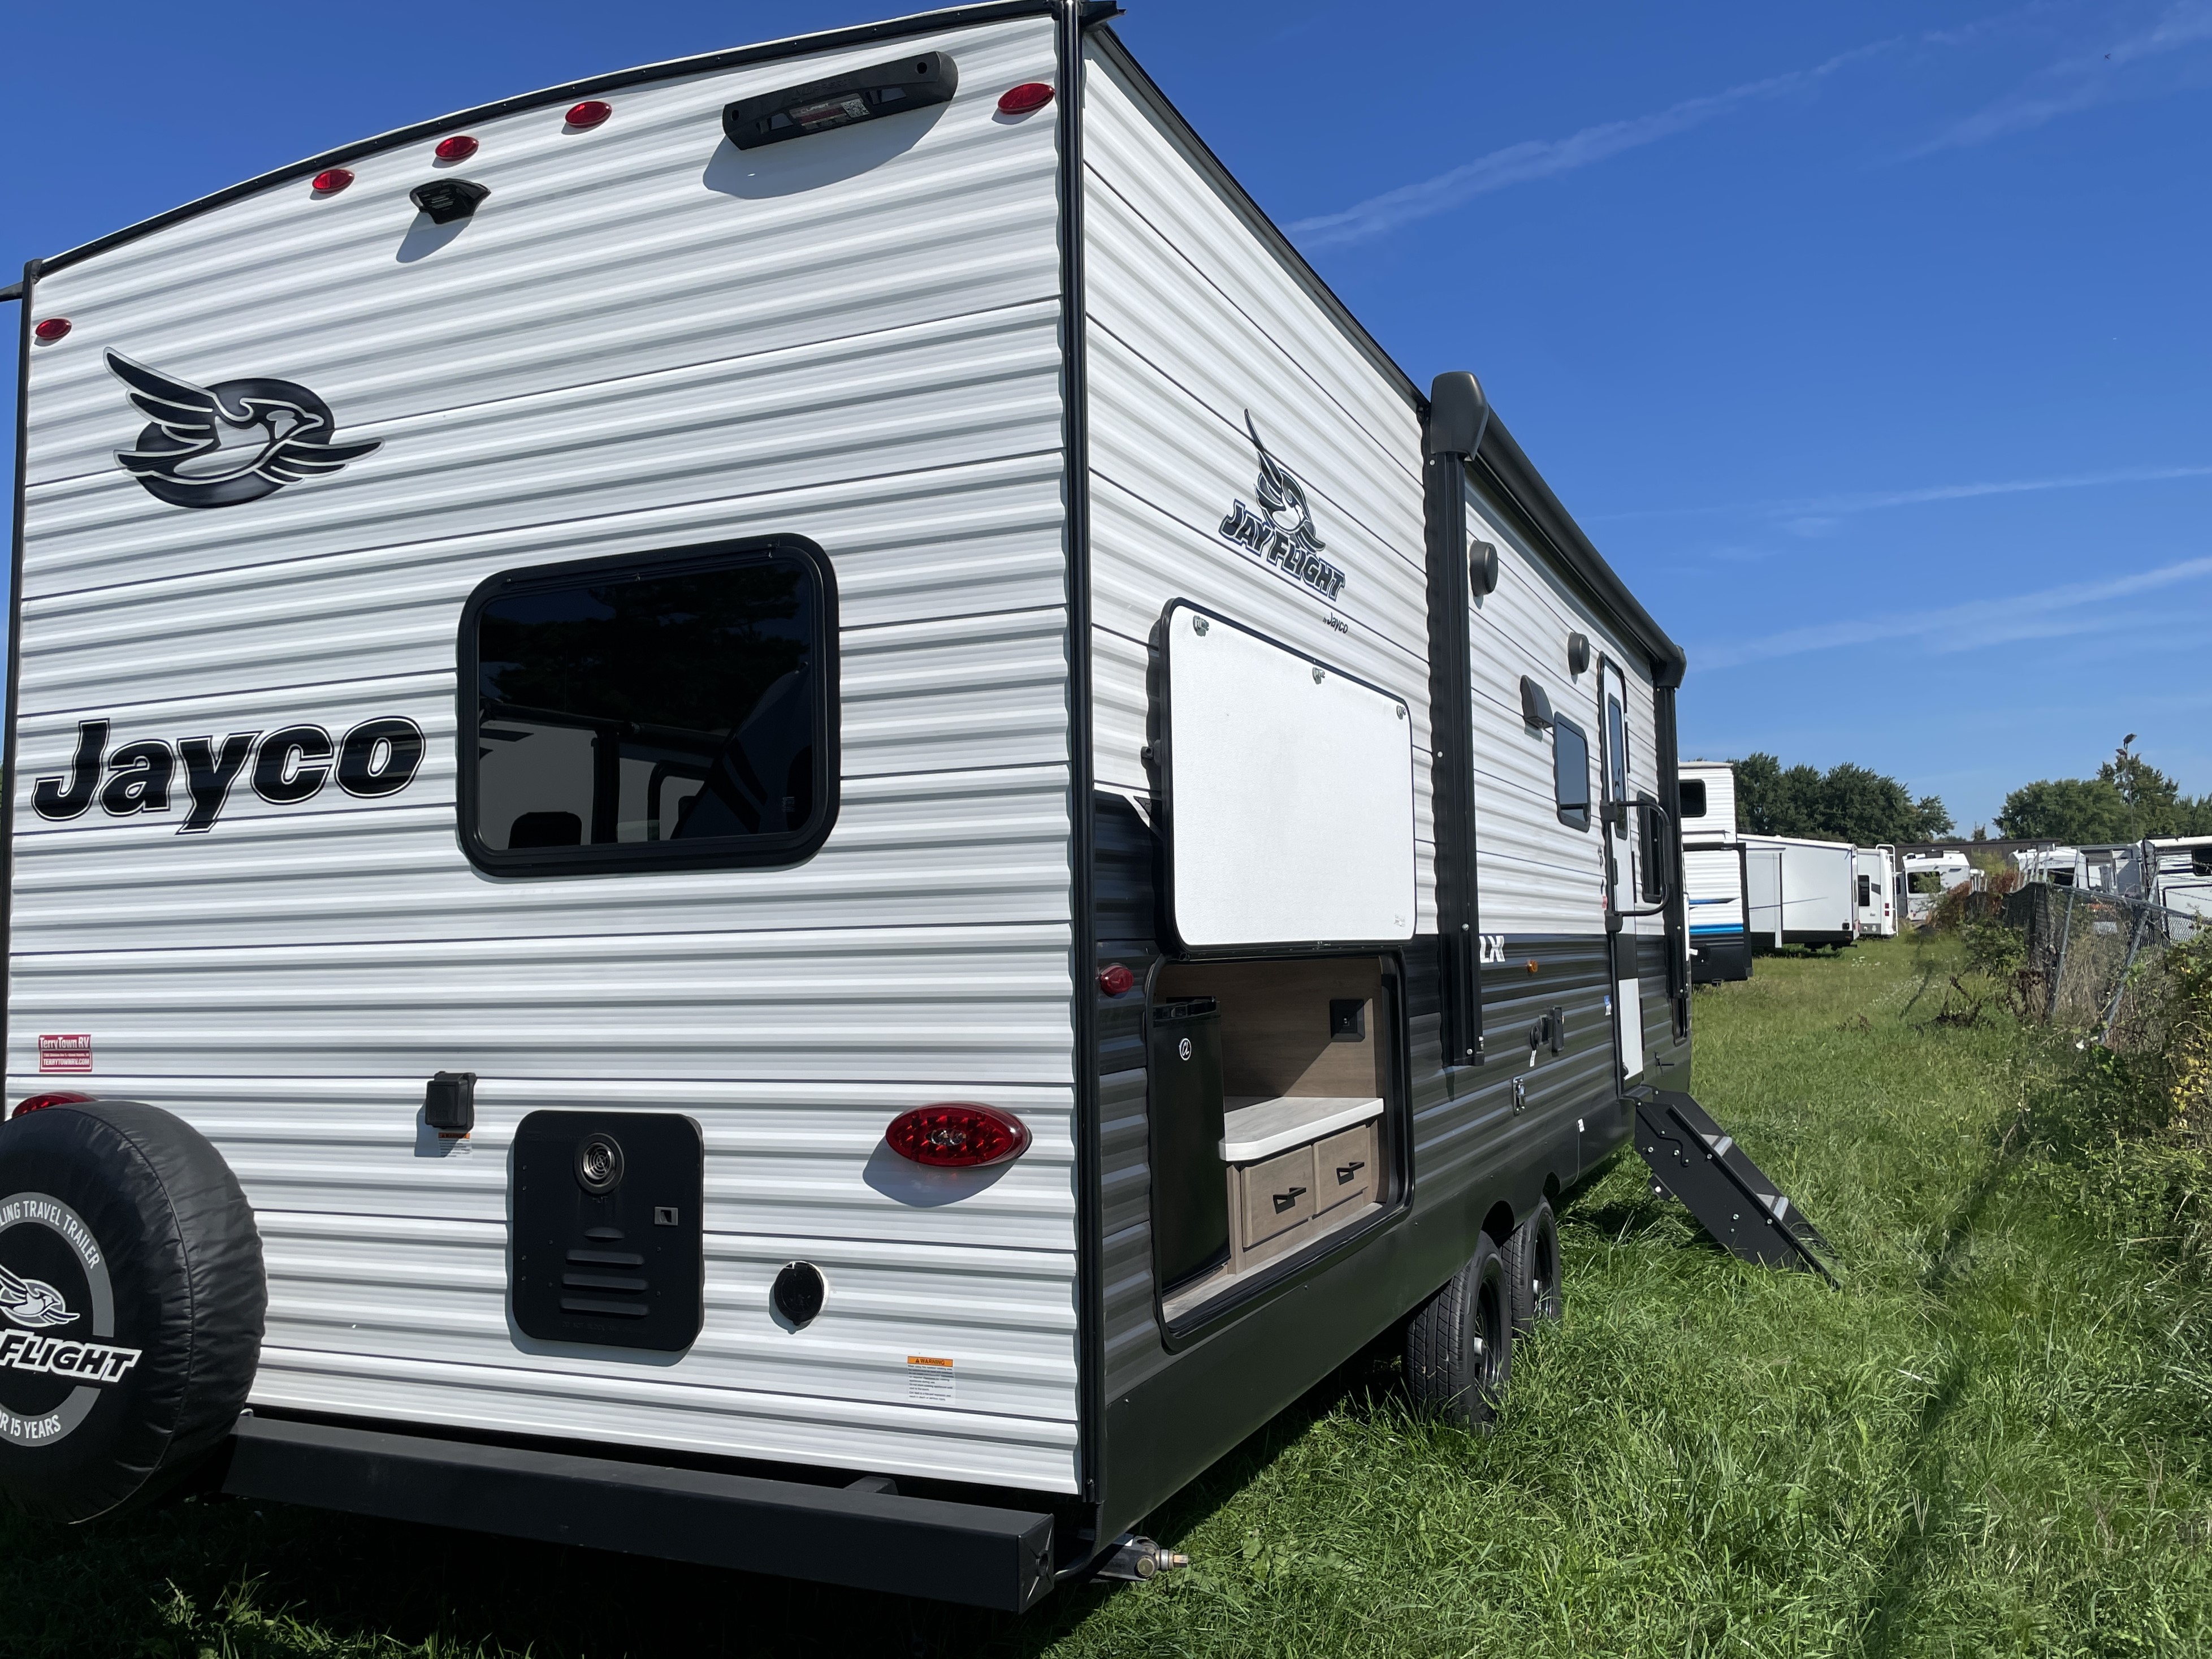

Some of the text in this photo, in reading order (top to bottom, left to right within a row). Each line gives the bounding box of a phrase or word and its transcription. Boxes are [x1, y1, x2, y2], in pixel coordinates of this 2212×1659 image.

[1219, 498, 1346, 602] JAY FLIGHT
[1327, 611, 1348, 634] Jayco
[31, 715, 426, 836] Jayco
[79, 1036, 89, 1048] RV
[23, 1200, 60, 1226] TRAVEL
[63, 1214, 100, 1269] TRAILER
[0, 1329, 142, 1382] FLIGHT
[11, 1418, 21, 1437] 15
[24, 1415, 61, 1439] YEARS
